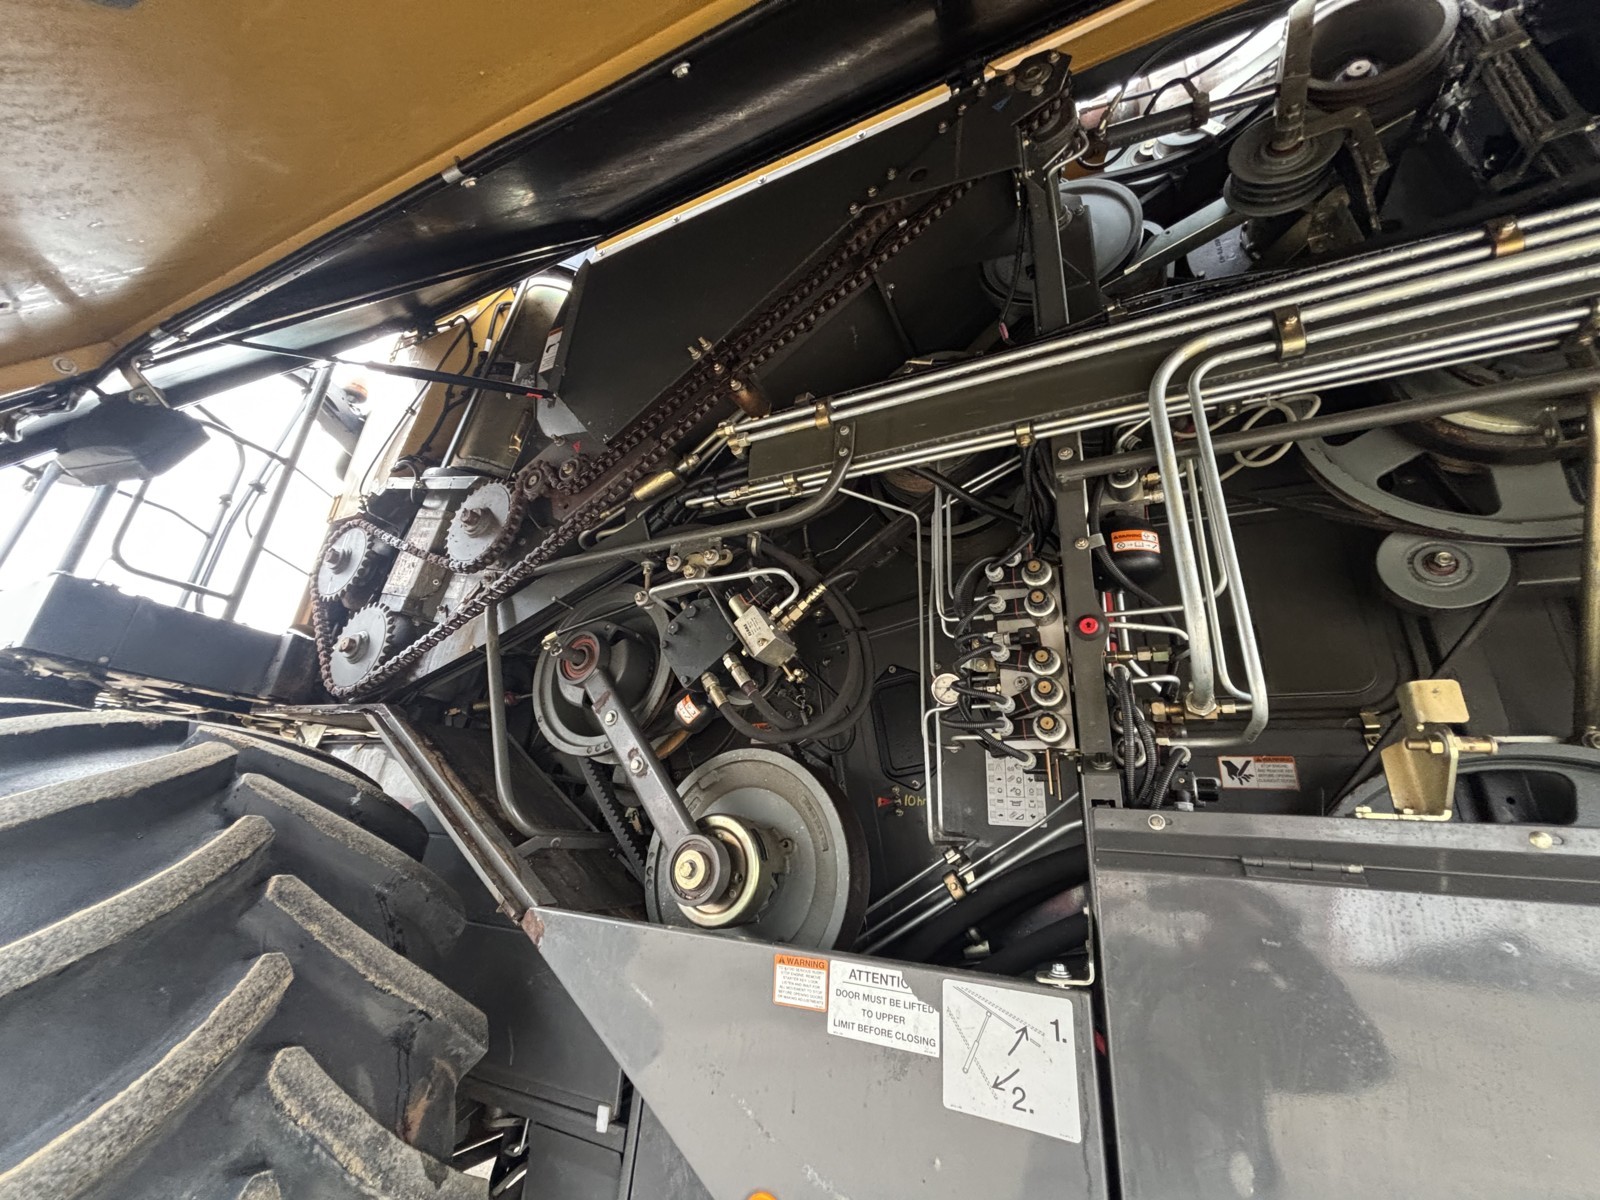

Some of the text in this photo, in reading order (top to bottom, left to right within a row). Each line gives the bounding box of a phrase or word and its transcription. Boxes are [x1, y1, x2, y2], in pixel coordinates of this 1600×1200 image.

[787, 957, 824, 969] WARNING
[849, 969, 910, 989] ATTENTIO
[836, 988, 934, 1014] DOOR MUST BE LIFTED
[861, 1009, 905, 1024] TO UPPER
[833, 1019, 936, 1047] LIMIT BEFORE CLOSING
[1050, 1018, 1068, 1044] 1.
[1012, 1086, 1034, 1114] 2.
